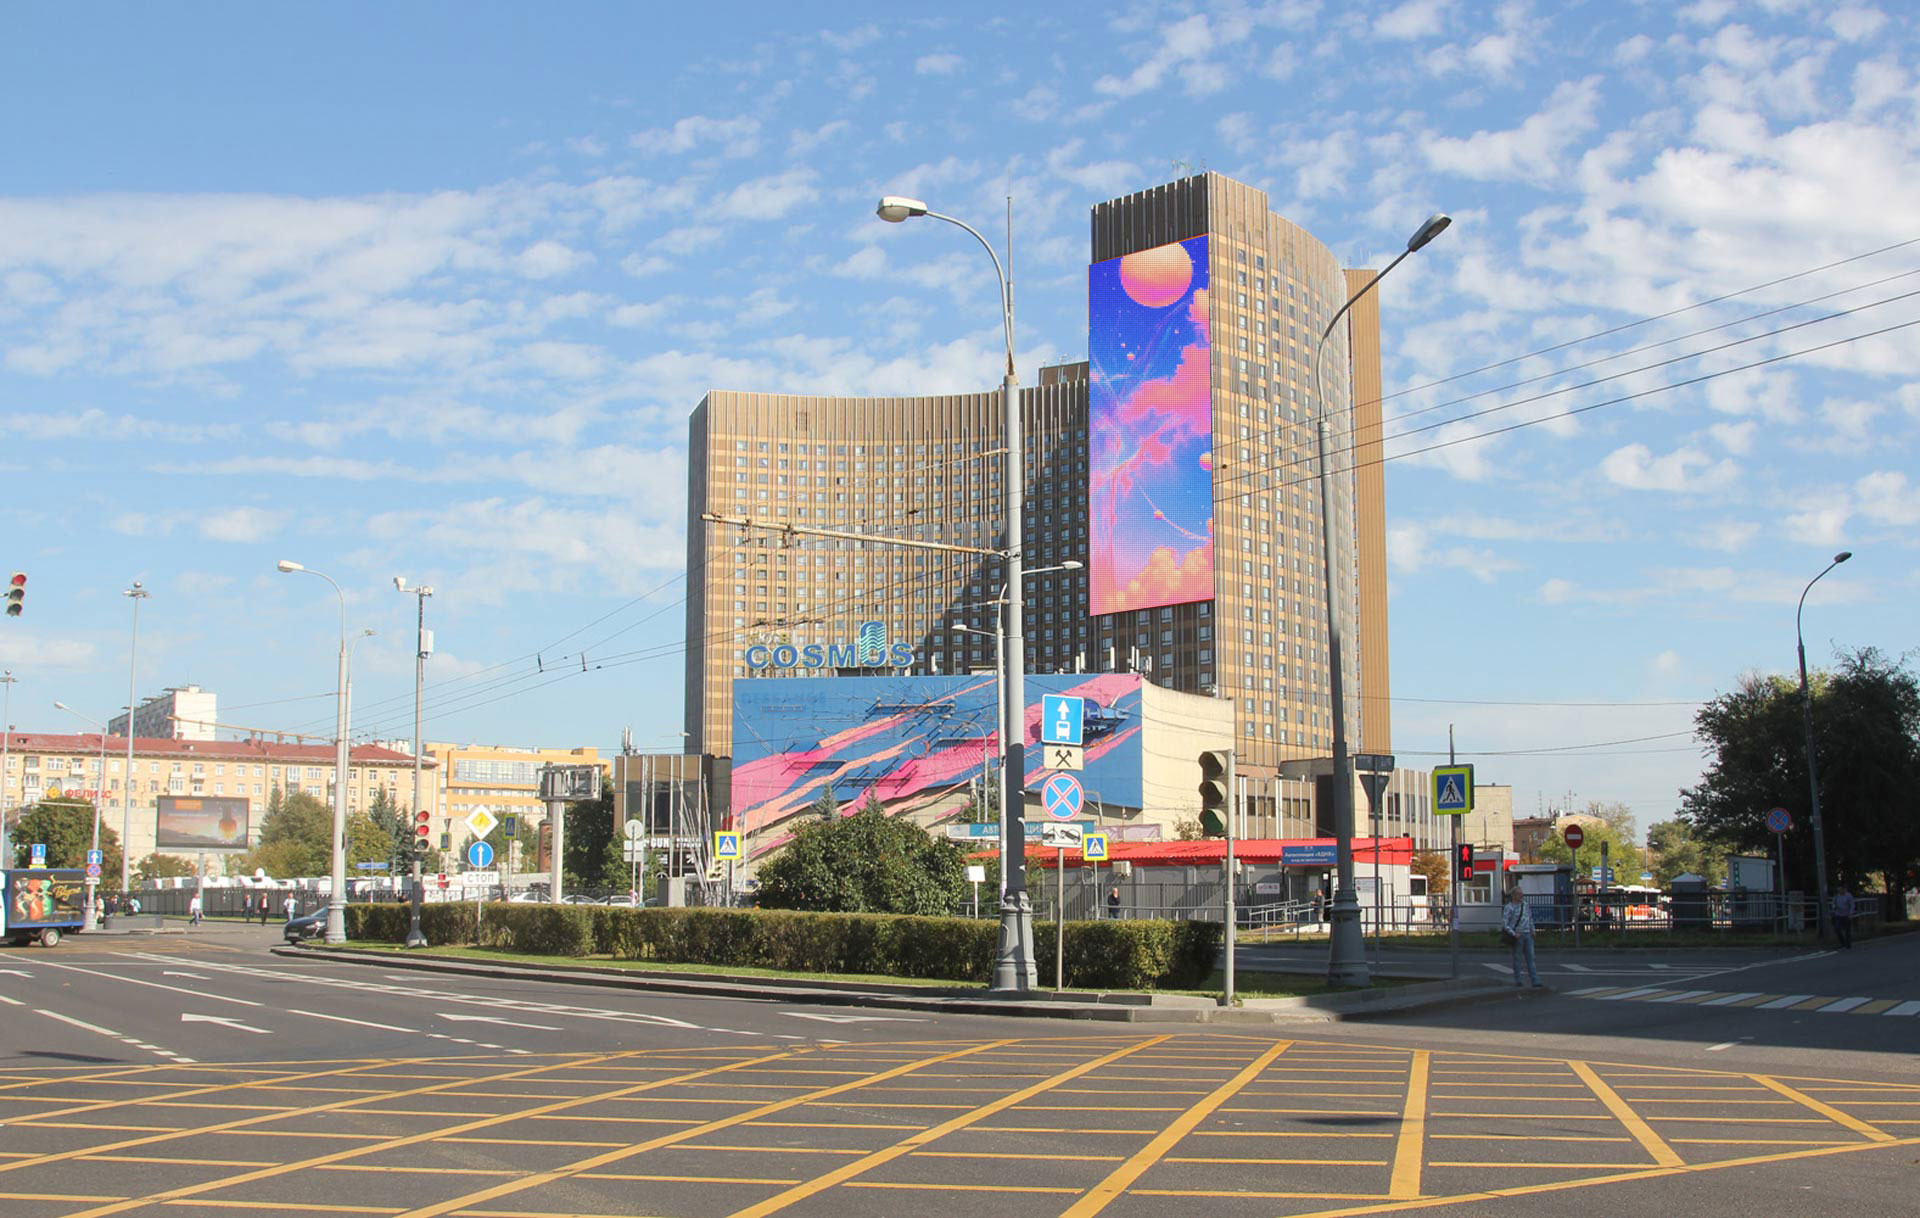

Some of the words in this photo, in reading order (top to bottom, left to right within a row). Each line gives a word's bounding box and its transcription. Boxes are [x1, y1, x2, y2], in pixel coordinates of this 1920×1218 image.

[745, 620, 915, 669] COSMOS
[64, 789, 113, 799] ФЕЛИС
[467, 873, 495, 883] СТОП
